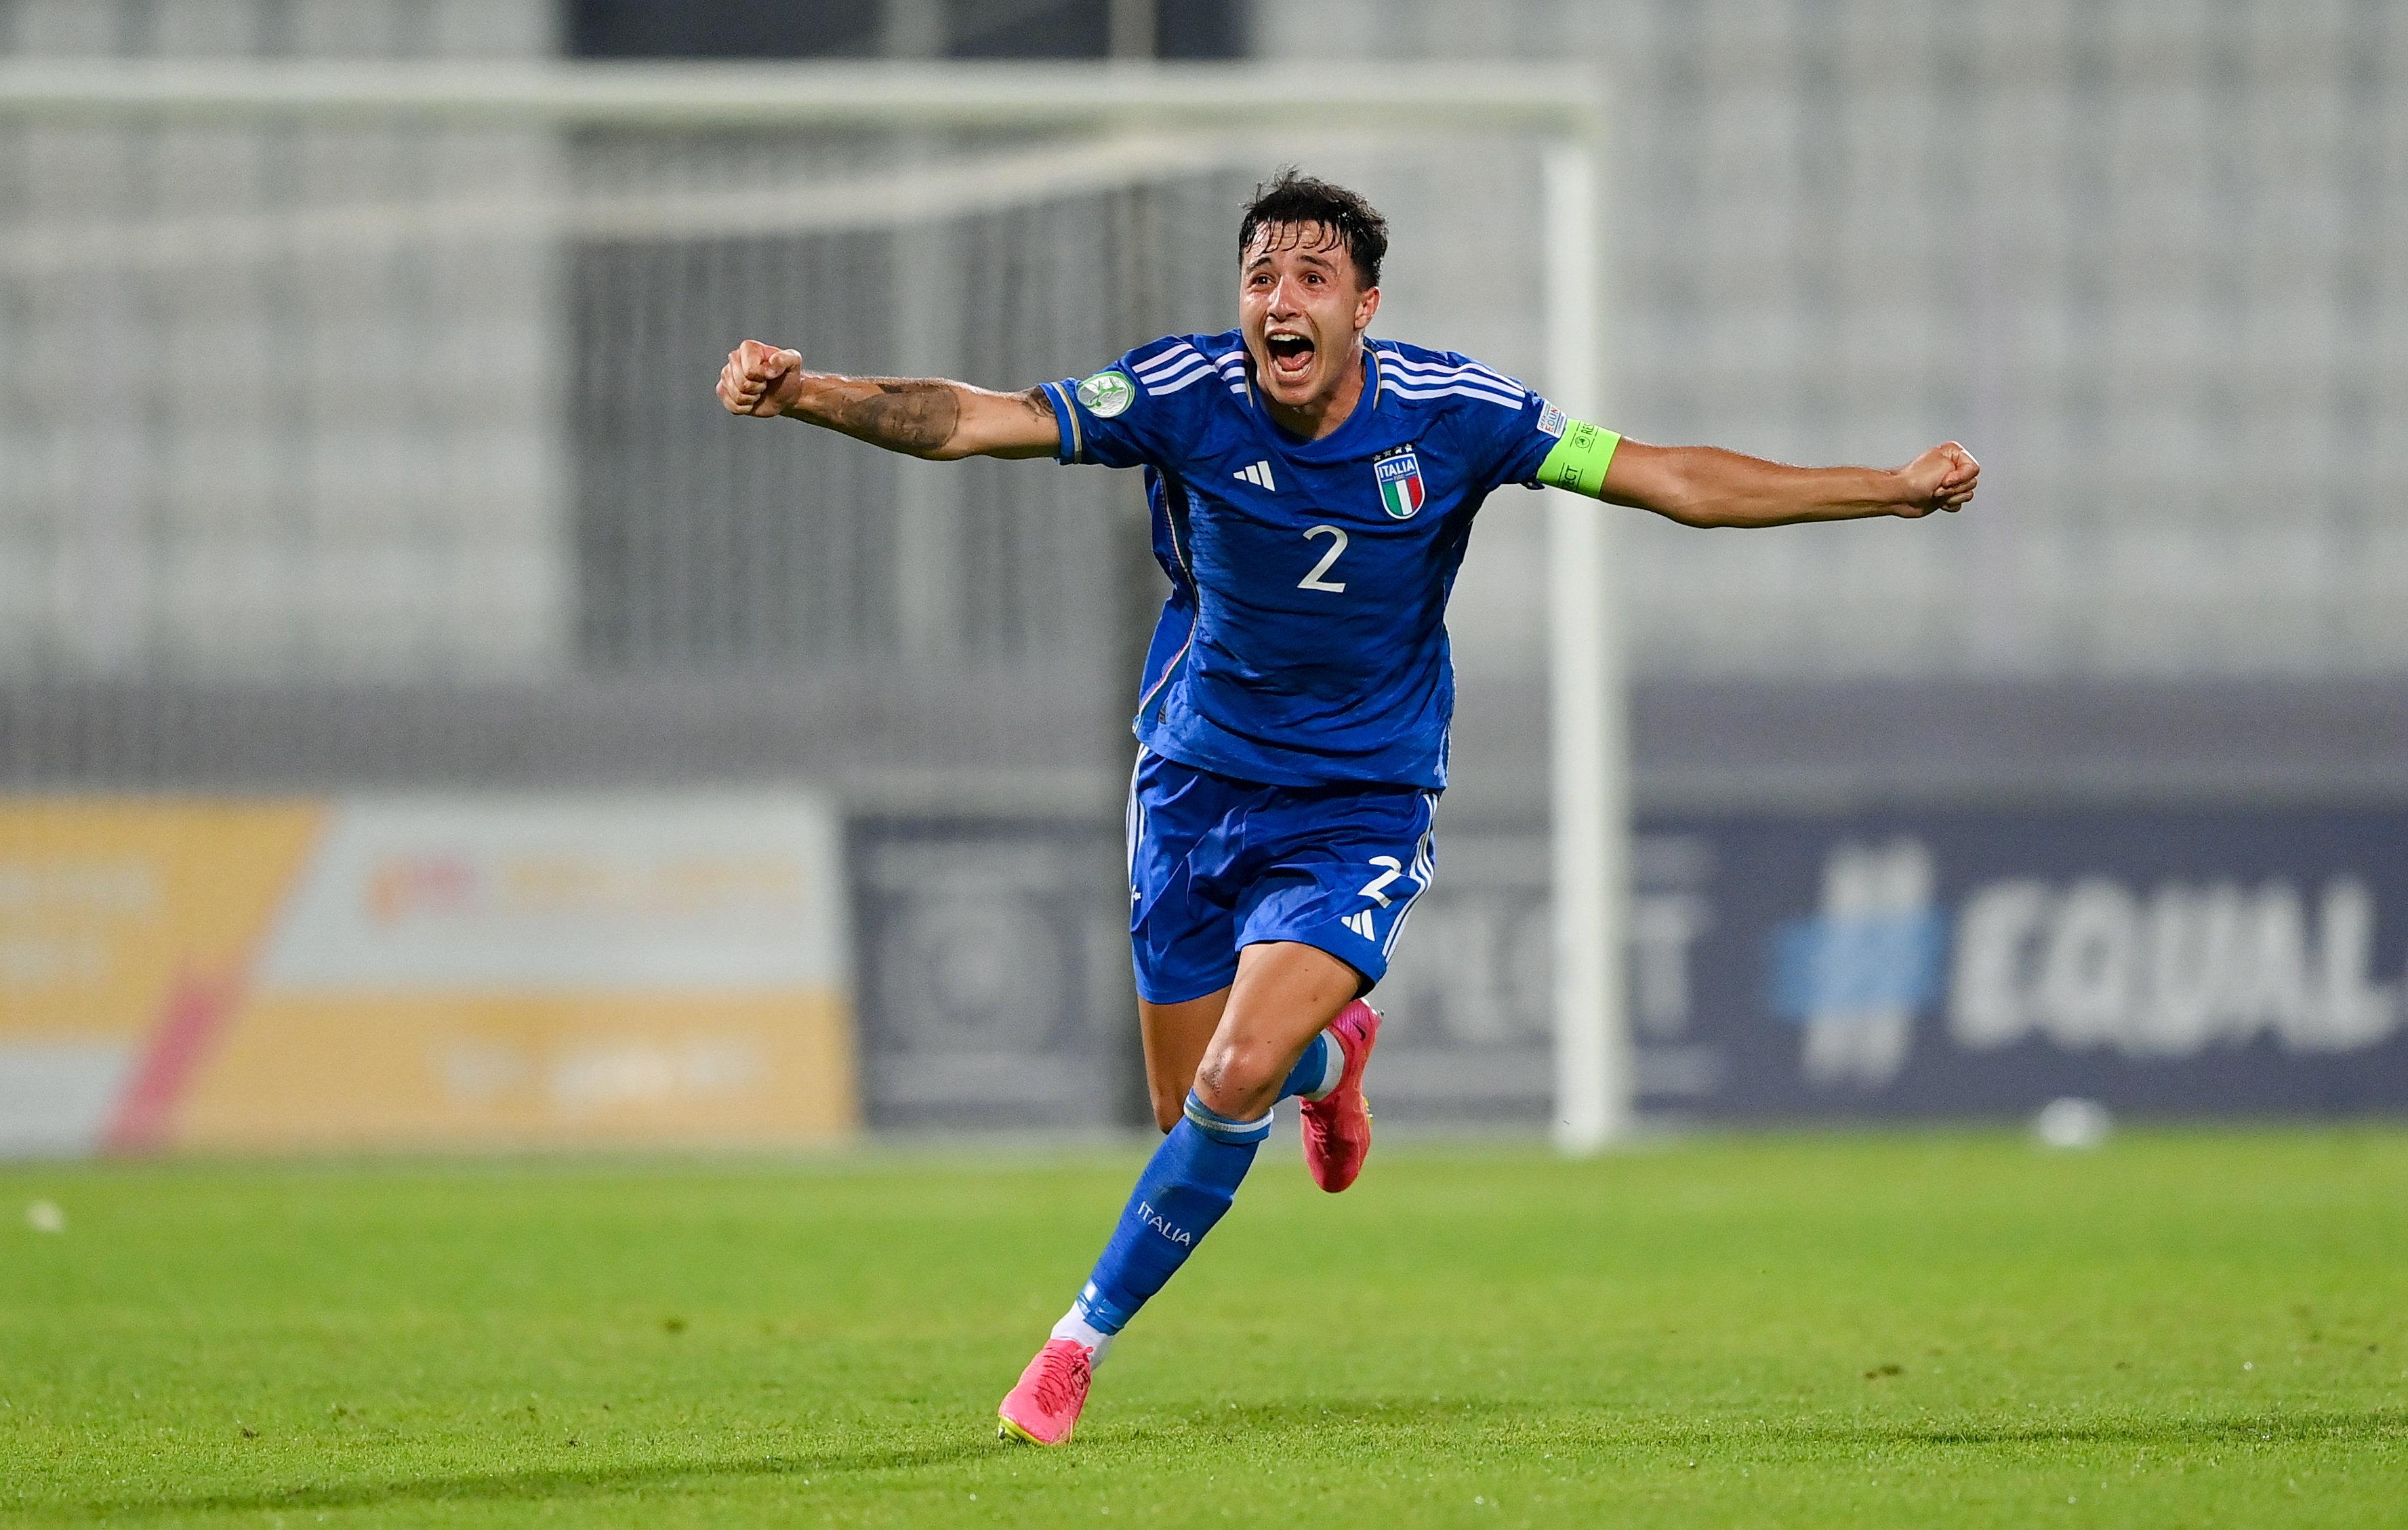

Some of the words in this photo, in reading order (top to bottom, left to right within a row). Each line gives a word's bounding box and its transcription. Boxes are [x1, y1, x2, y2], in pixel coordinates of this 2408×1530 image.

[1379, 459, 1415, 478] ITALIA
[1297, 525, 1348, 593] 2
[1357, 855, 1402, 909] 2
[1137, 1201, 1191, 1246] ITALIA
